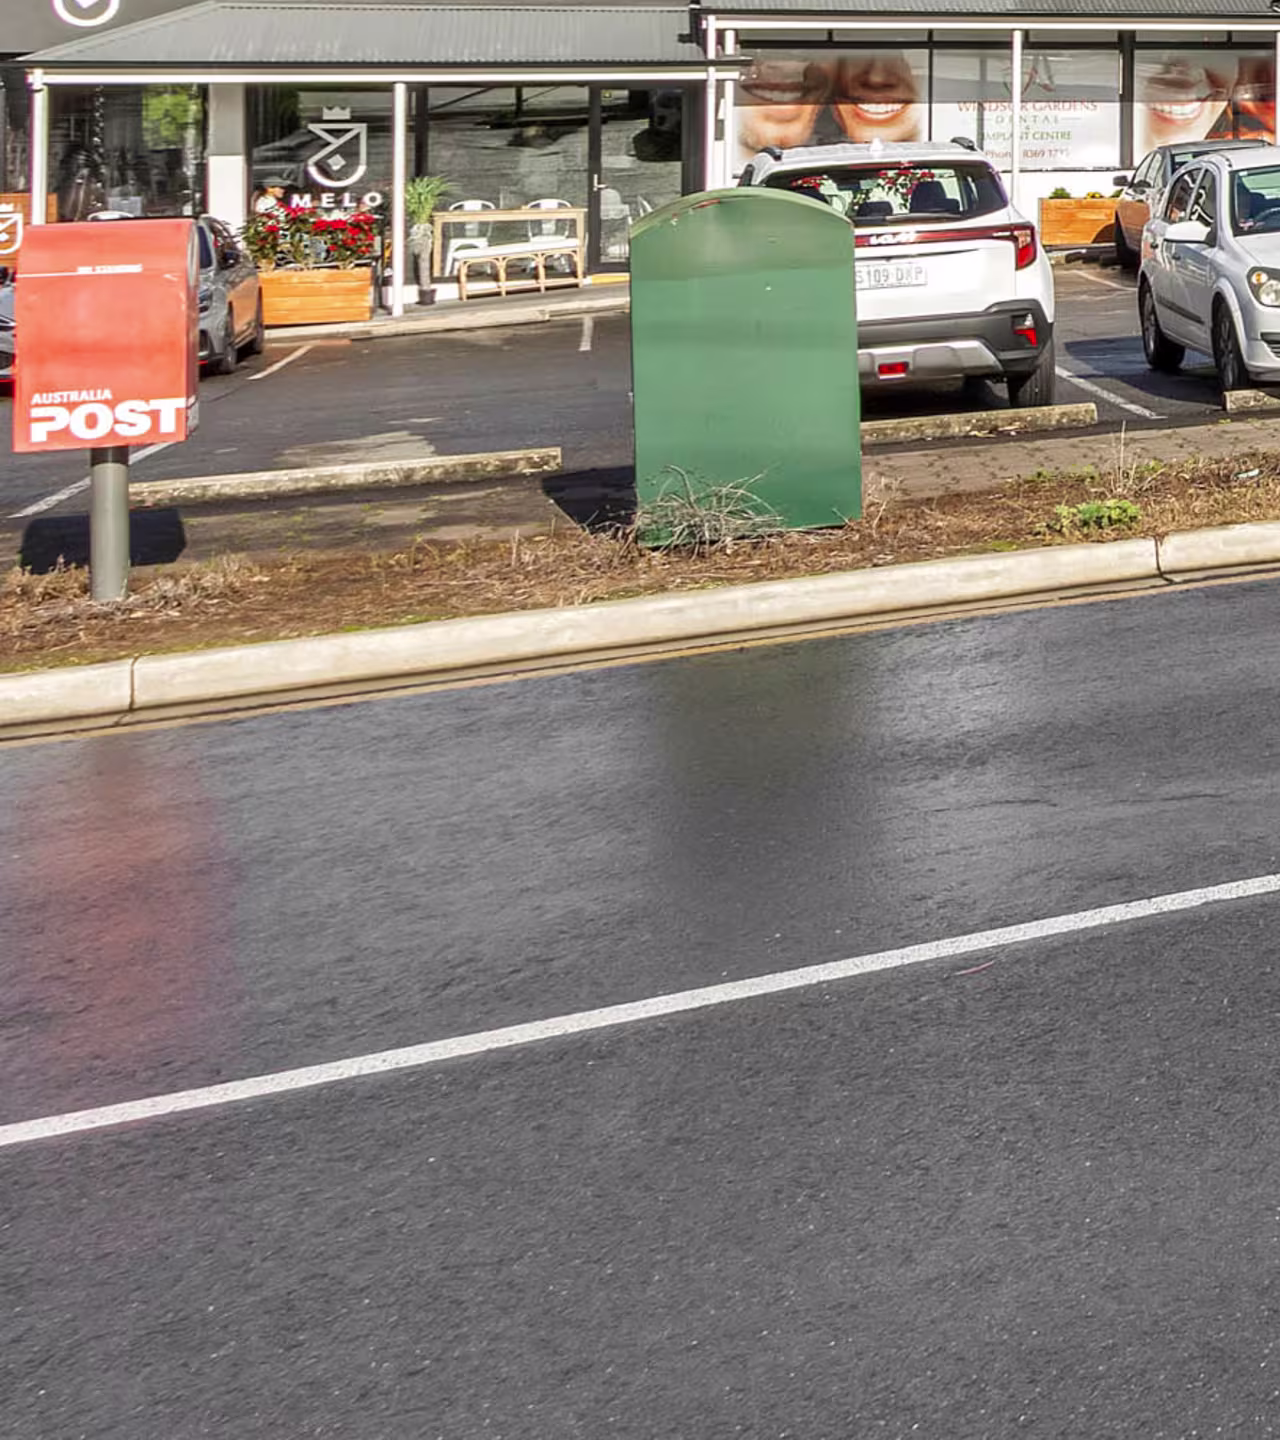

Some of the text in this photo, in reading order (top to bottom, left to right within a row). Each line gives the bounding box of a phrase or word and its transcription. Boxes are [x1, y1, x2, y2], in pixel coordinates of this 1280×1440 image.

[291, 192, 382, 208] MELO
[31, 389, 113, 405] AUSTRALIA
[30, 397, 187, 443] POST
